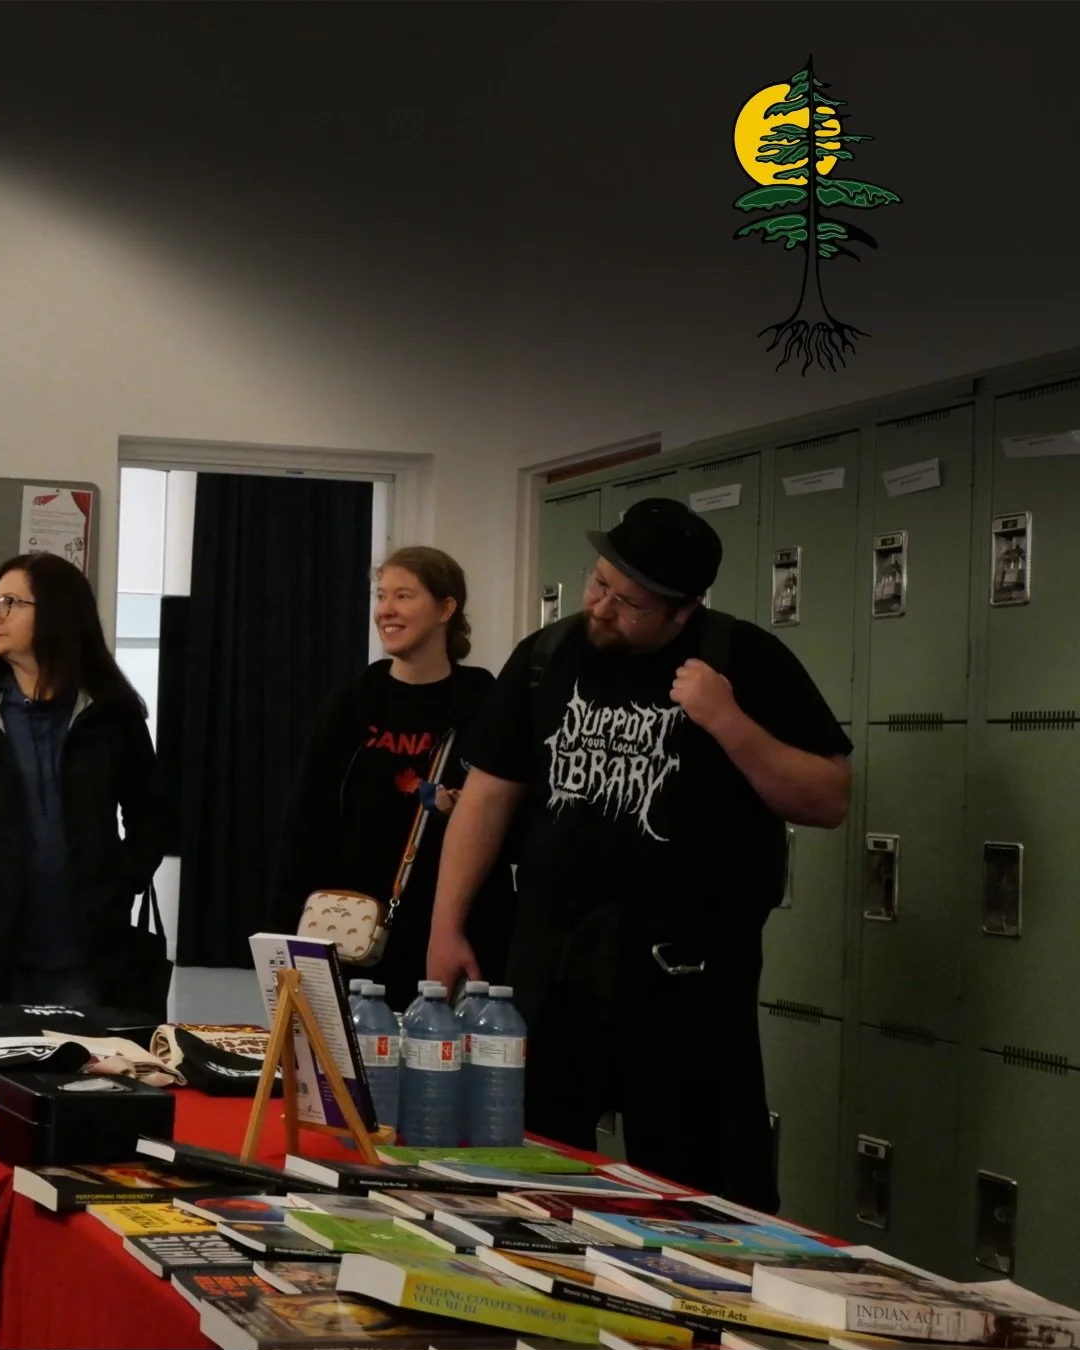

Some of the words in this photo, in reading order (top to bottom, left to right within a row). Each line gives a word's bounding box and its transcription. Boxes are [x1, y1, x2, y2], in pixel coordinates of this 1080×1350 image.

[563, 677, 687, 760] SUPPORT
[363, 723, 433, 756] CANA
[581, 736, 606, 749] YOUR
[611, 742, 639, 755] LOCAL
[544, 728, 680, 842] LIBRARY
[139, 1236, 209, 1265] WHITE
[181, 1235, 253, 1264] NOISE
[414, 1282, 464, 1301] STAGING
[523, 1305, 567, 1322] DREAM
[680, 1300, 726, 1317] Two-Spirit
[728, 1310, 747, 1322] Acts
[856, 1304, 911, 1321] INDIAN
[914, 1311, 944, 1326] ACT
